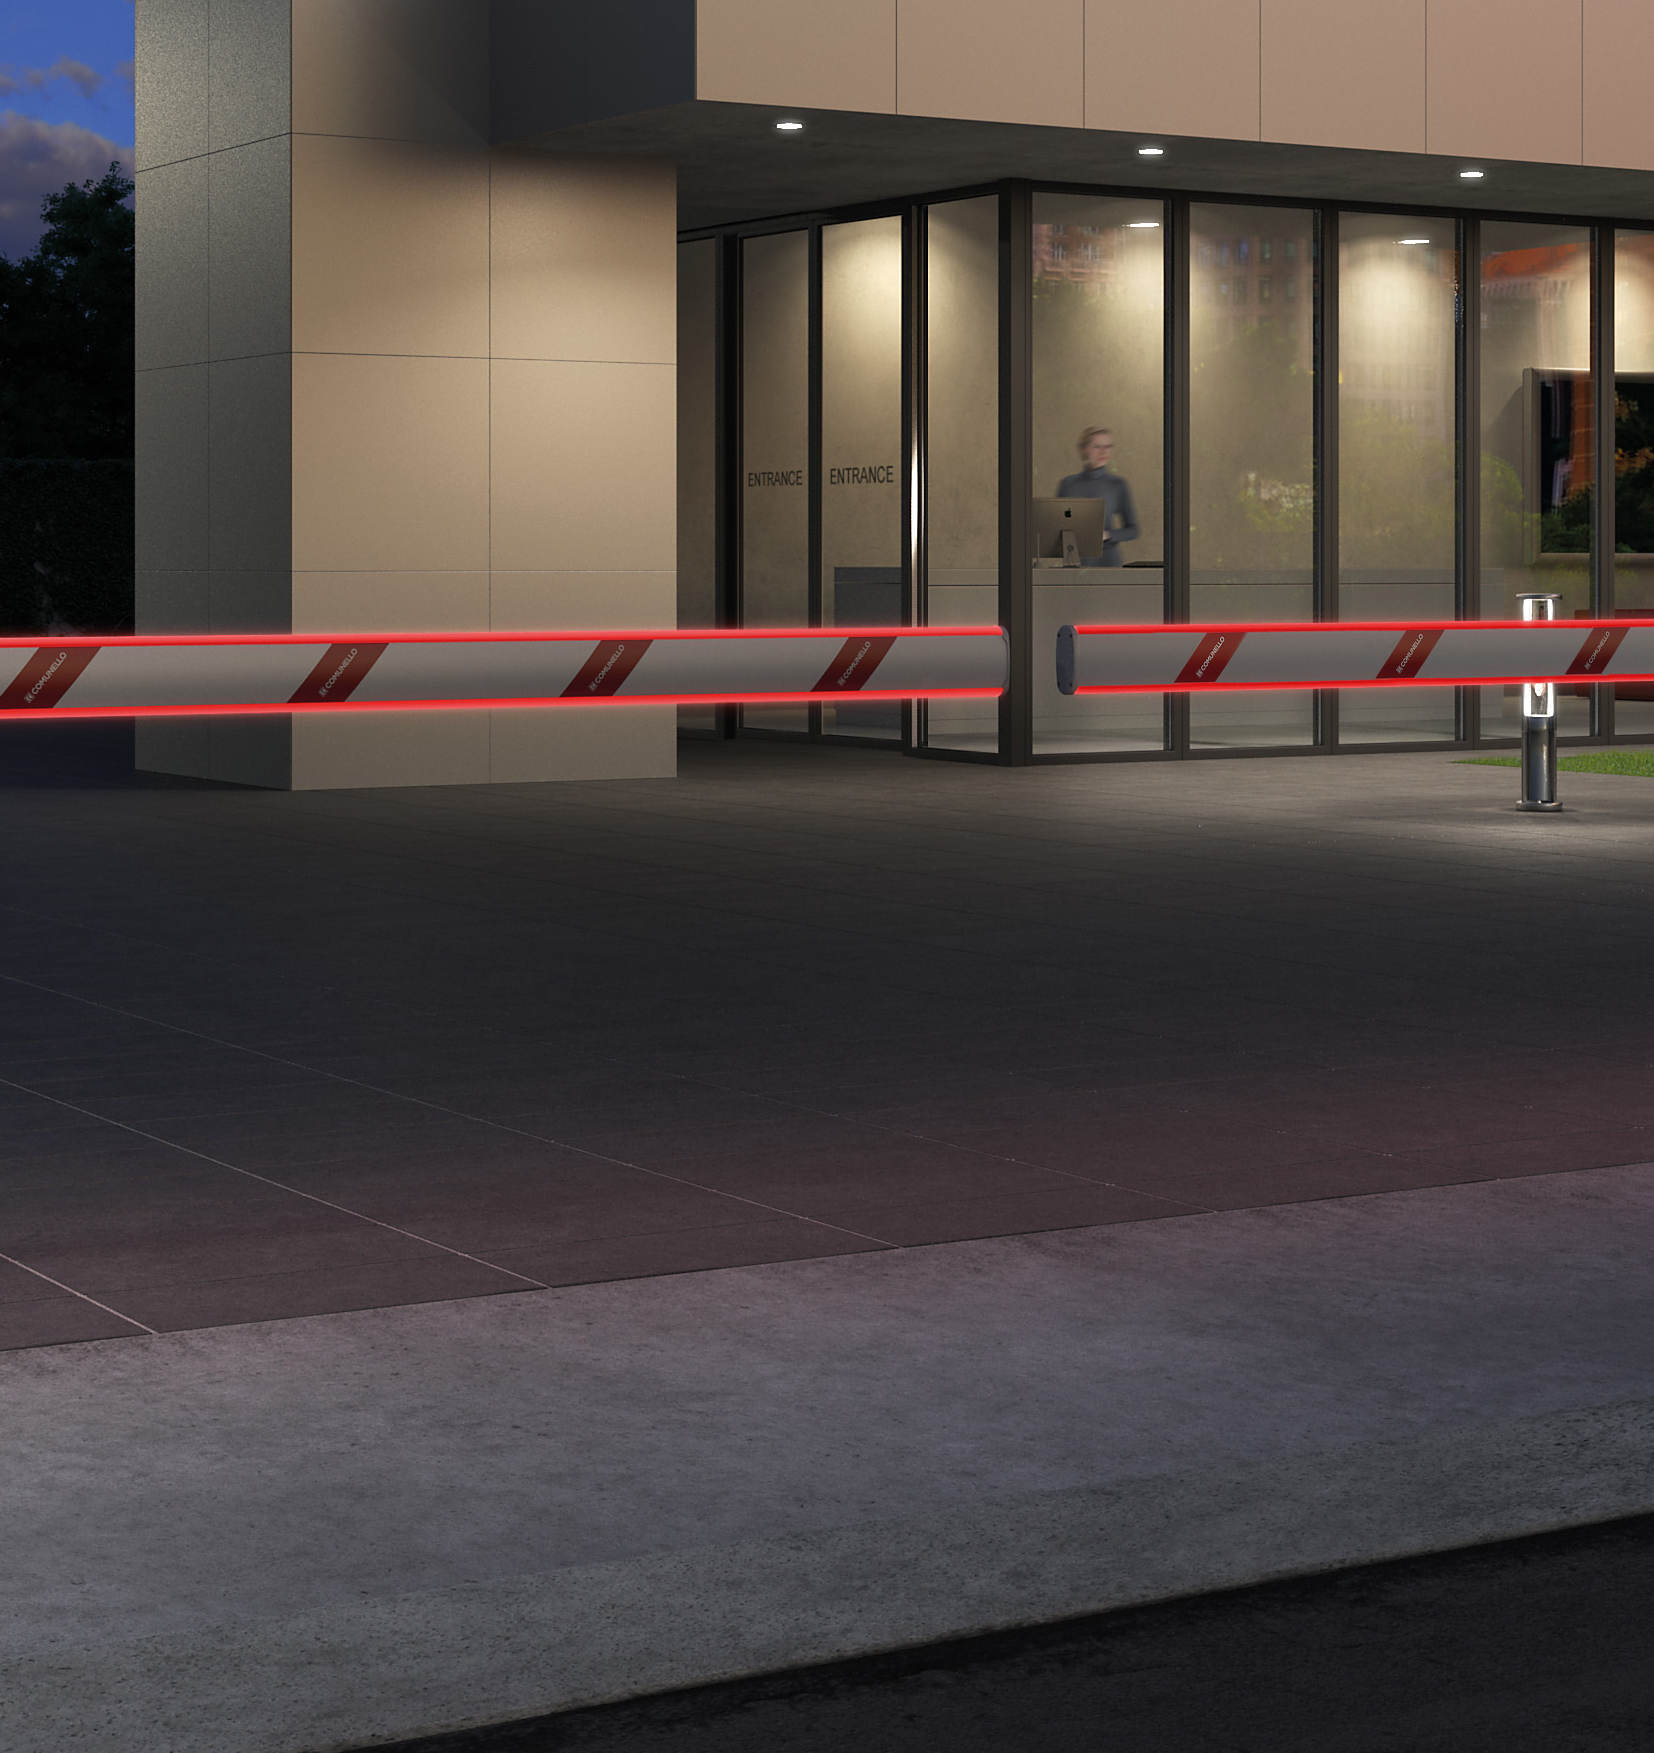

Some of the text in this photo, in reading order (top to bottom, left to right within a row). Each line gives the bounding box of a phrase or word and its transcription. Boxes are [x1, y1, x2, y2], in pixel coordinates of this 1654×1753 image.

[748, 470, 803, 487] ENTRANCE
[830, 465, 894, 485] ENTRANCE
[594, 644, 625, 684] COMUNELLO
[843, 640, 871, 679] COMUNELLO
[1200, 636, 1225, 671] COMUNELLO
[1400, 633, 1424, 668] COMUNELLO
[1588, 631, 1611, 664] COMUNELLO
[31, 652, 67, 695] COMUNELLO
[325, 648, 358, 689] COMUNELLO
